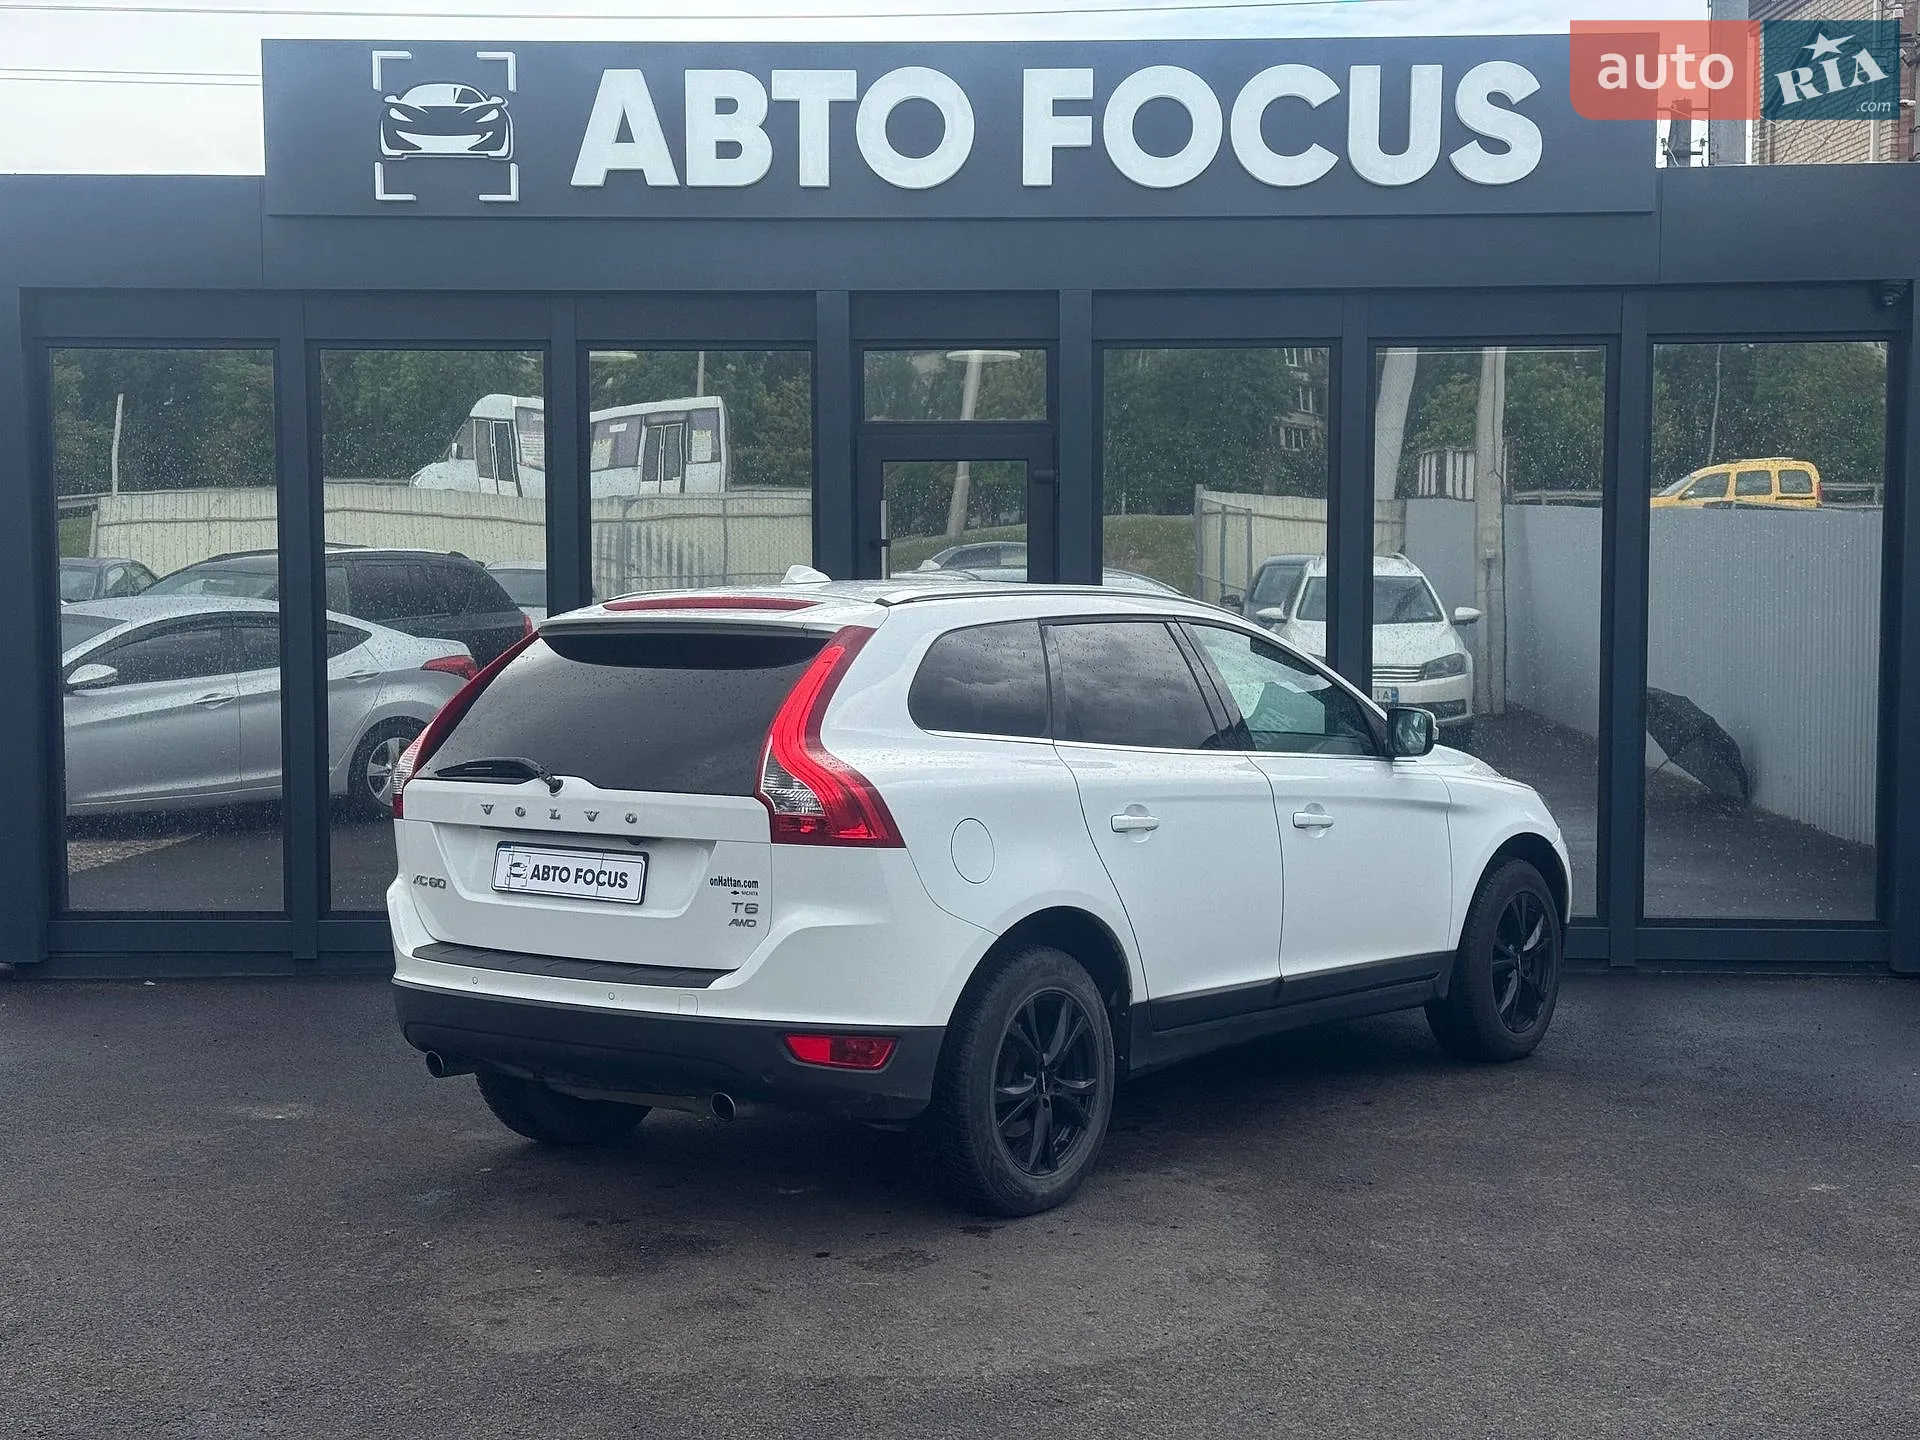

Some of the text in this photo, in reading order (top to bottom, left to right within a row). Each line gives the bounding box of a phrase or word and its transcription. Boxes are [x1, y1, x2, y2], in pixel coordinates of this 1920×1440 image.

[570, 61, 1543, 189] АВТО FOCUS
[481, 803, 638, 824] VOLVO
[530, 864, 629, 889] АВТО FOCUS
[731, 902, 759, 914] T6
[728, 918, 757, 928] AWD
